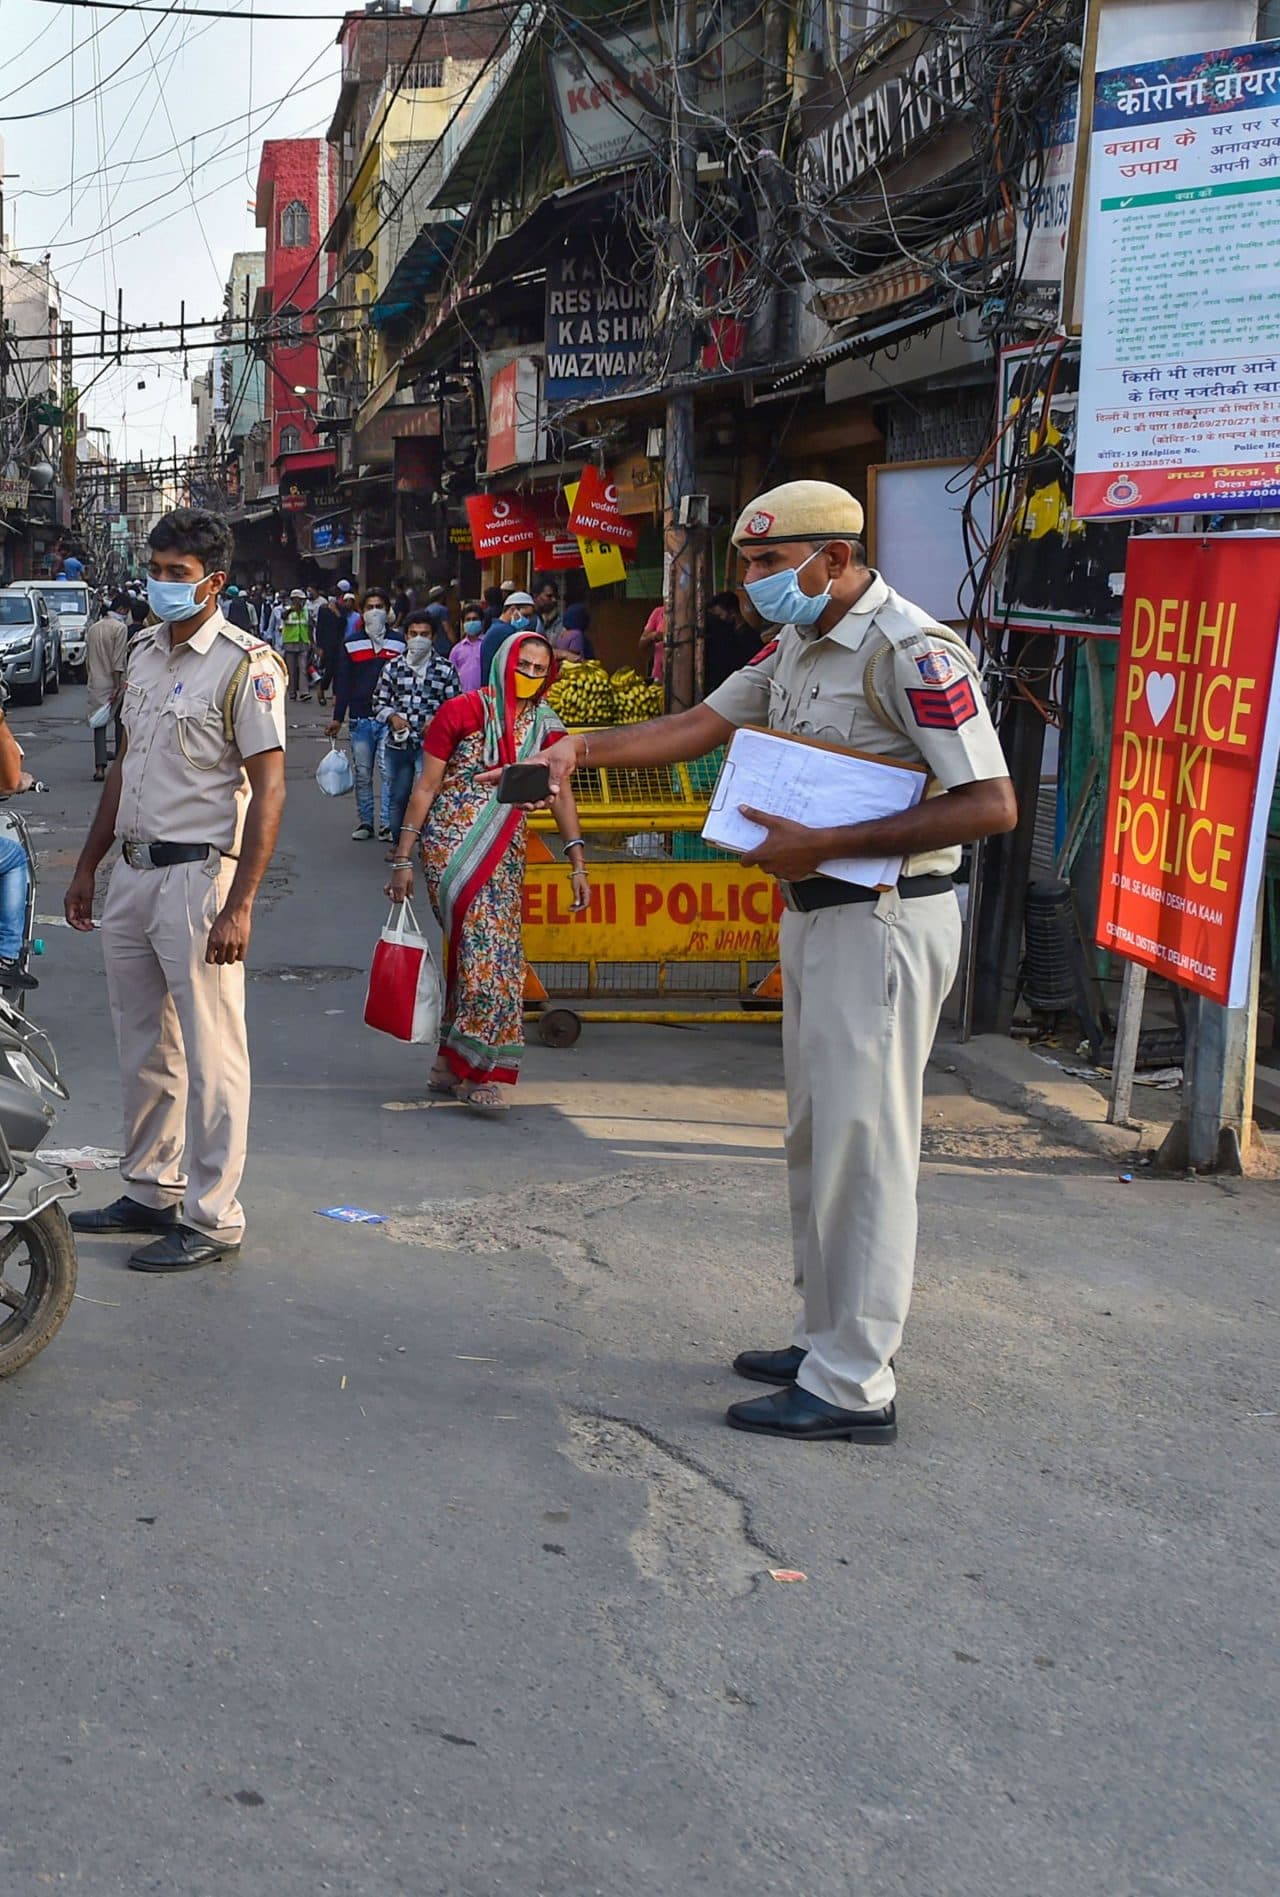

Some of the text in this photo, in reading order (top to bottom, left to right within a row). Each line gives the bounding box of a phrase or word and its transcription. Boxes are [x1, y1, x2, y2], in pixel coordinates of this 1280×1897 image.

[1117, 74, 1208, 115] कोरोना
[820, 83, 892, 194] YASEEN
[1212, 124, 1233, 136] घर
[1242, 120, 1262, 133] पर
[1104, 128, 1198, 157] बचाव के
[1119, 158, 1179, 178] उपाय
[1209, 156, 1250, 175] अपनी
[549, 280, 654, 315] RESTAUR
[558, 316, 654, 346] KASHM
[1122, 358, 1277, 384] किसी भी लक्षण आने
[1128, 389, 1144, 403] के
[1149, 387, 1180, 402] लिए
[1254, 380, 1280, 393] स्वा
[1113, 425, 1131, 434] IPC
[1141, 448, 1180, 459] Helpline
[1234, 441, 1280, 452] Police He
[590, 500, 618, 514] vodafo
[485, 517, 521, 530] vodafo
[575, 514, 633, 538] MNP Centre
[479, 536, 502, 549] MNP
[503, 530, 534, 545] Centre
[1130, 597, 1237, 669] DELHI
[1120, 731, 1212, 812] DIL KI
[1113, 796, 1235, 892] POLICE
[521, 882, 616, 925] ELHI
[1111, 871, 1223, 926] JO DIL SE KAREN DESH KA KAAM
[715, 929, 761, 951] JAMA
[1106, 921, 1135, 945] CENTRAL
[1167, 948, 1189, 968] DELHI
[1190, 956, 1217, 981] POLICE
